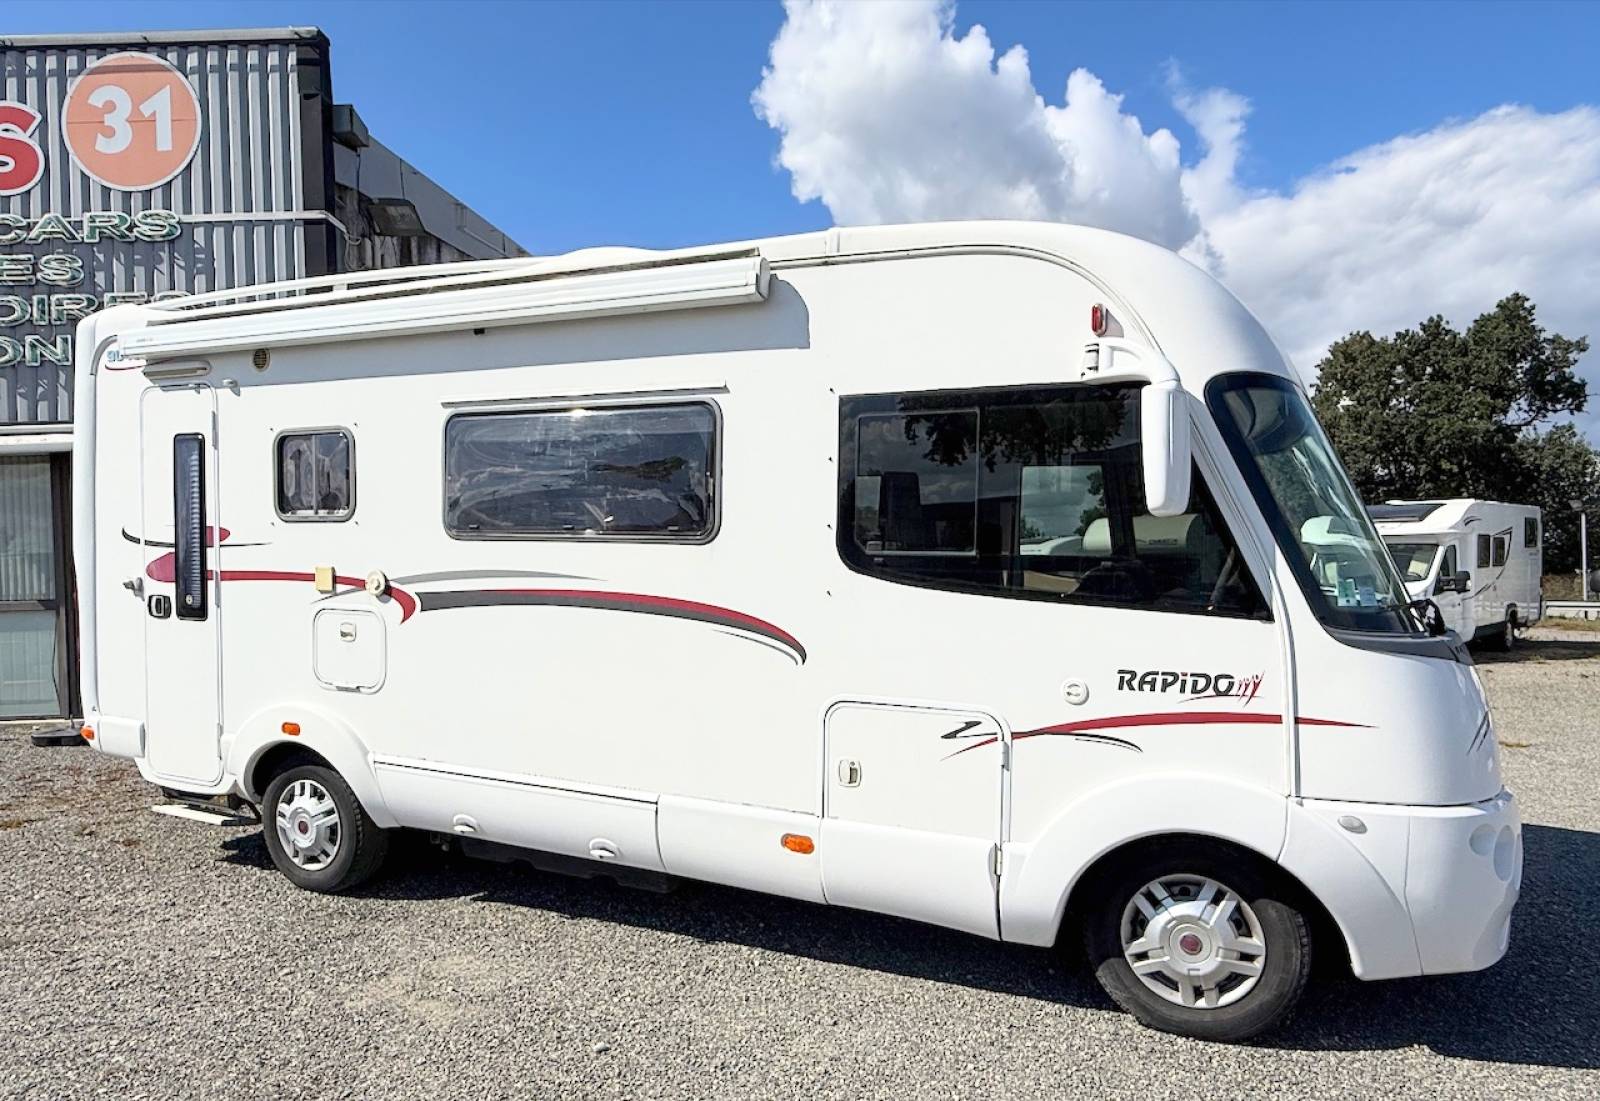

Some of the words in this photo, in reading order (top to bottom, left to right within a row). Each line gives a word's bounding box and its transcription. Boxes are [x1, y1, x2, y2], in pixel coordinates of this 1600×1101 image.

[88, 85, 173, 154] 31
[0, 209, 182, 245] CARS
[0, 254, 85, 288] ES
